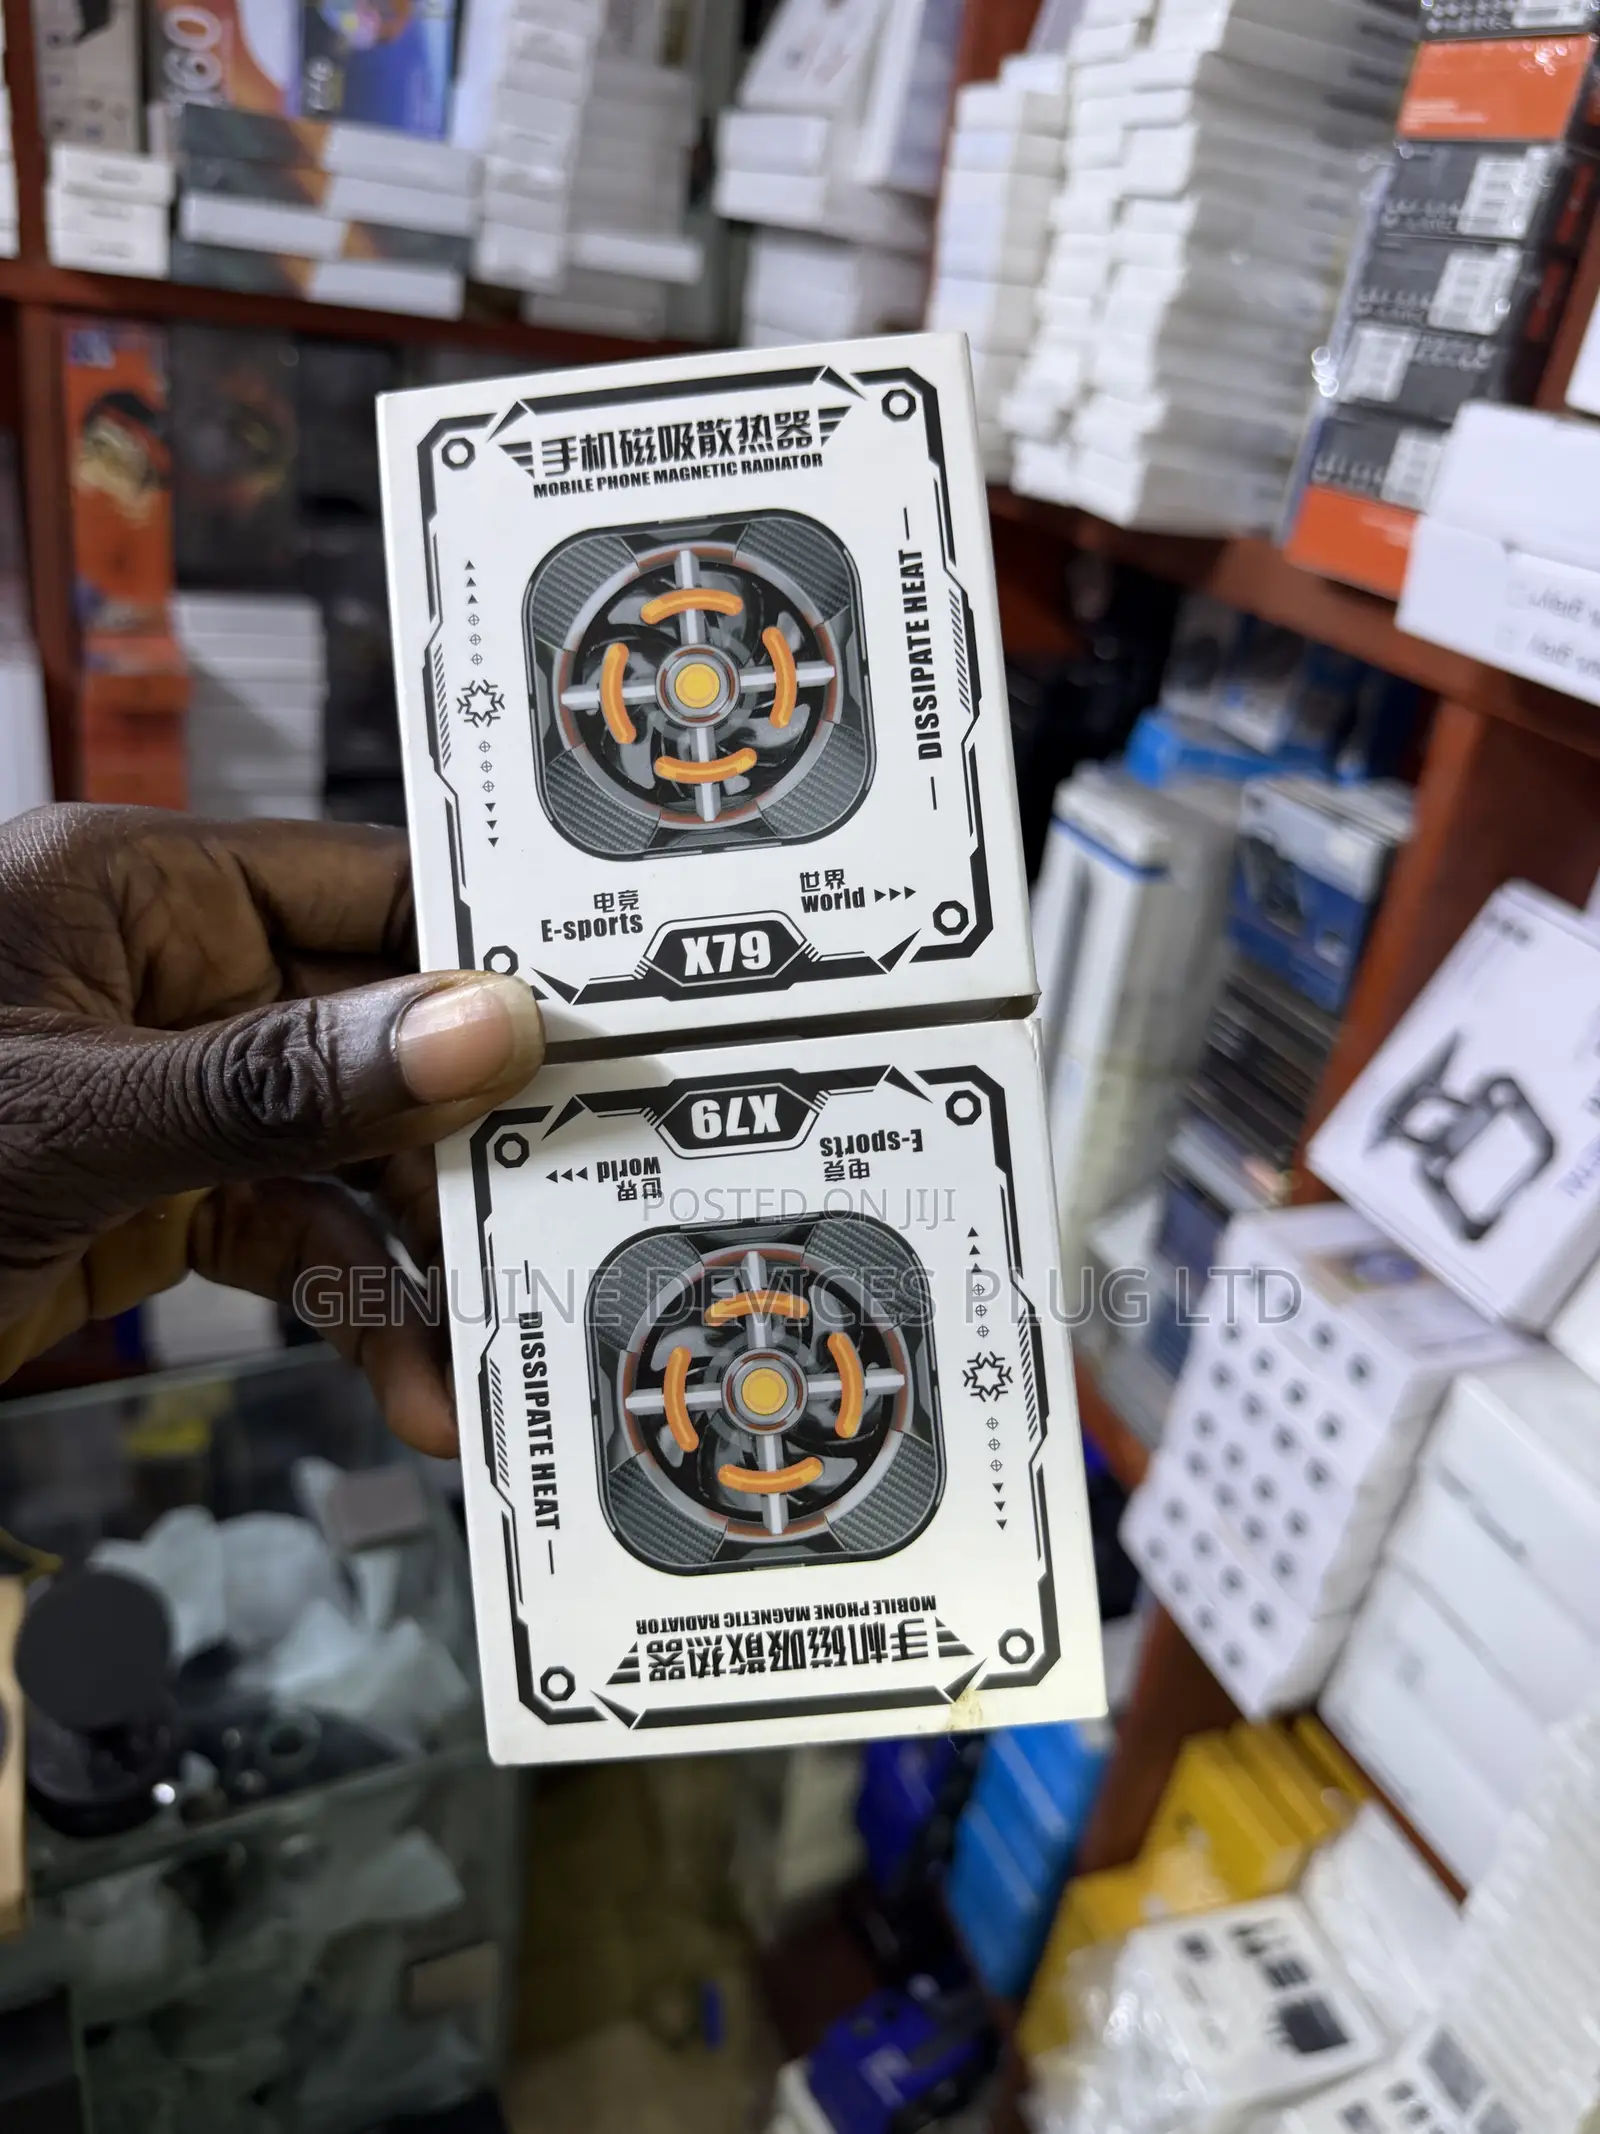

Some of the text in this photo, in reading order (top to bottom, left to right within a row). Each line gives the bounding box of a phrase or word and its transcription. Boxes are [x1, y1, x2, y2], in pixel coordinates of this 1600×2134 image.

[541, 409, 814, 479] 手机磁吸散热器
[533, 453, 823, 499] MOBILE PHONE MAGNETIC RADIATOR
[898, 549, 942, 760] DISSIPATE HEAT
[800, 868, 846, 893] 世界
[593, 889, 640, 914] 电竞
[801, 886, 866, 913] world
[541, 912, 644, 943] E-sports
[681, 930, 773, 978] X79
[690, 1093, 781, 1141] X79
[820, 1129, 924, 1157] E-sports
[596, 1156, 662, 1184] world
[824, 1158, 871, 1183] 电竞
[616, 1177, 663, 1202] 世界
[518, 1311, 560, 1530] DISSIPATE HEAT
[636, 1595, 937, 1635] MOBILE PHONE MAGNETIC RADIATOR
[647, 1617, 929, 1682] 手机磁吸散热器
